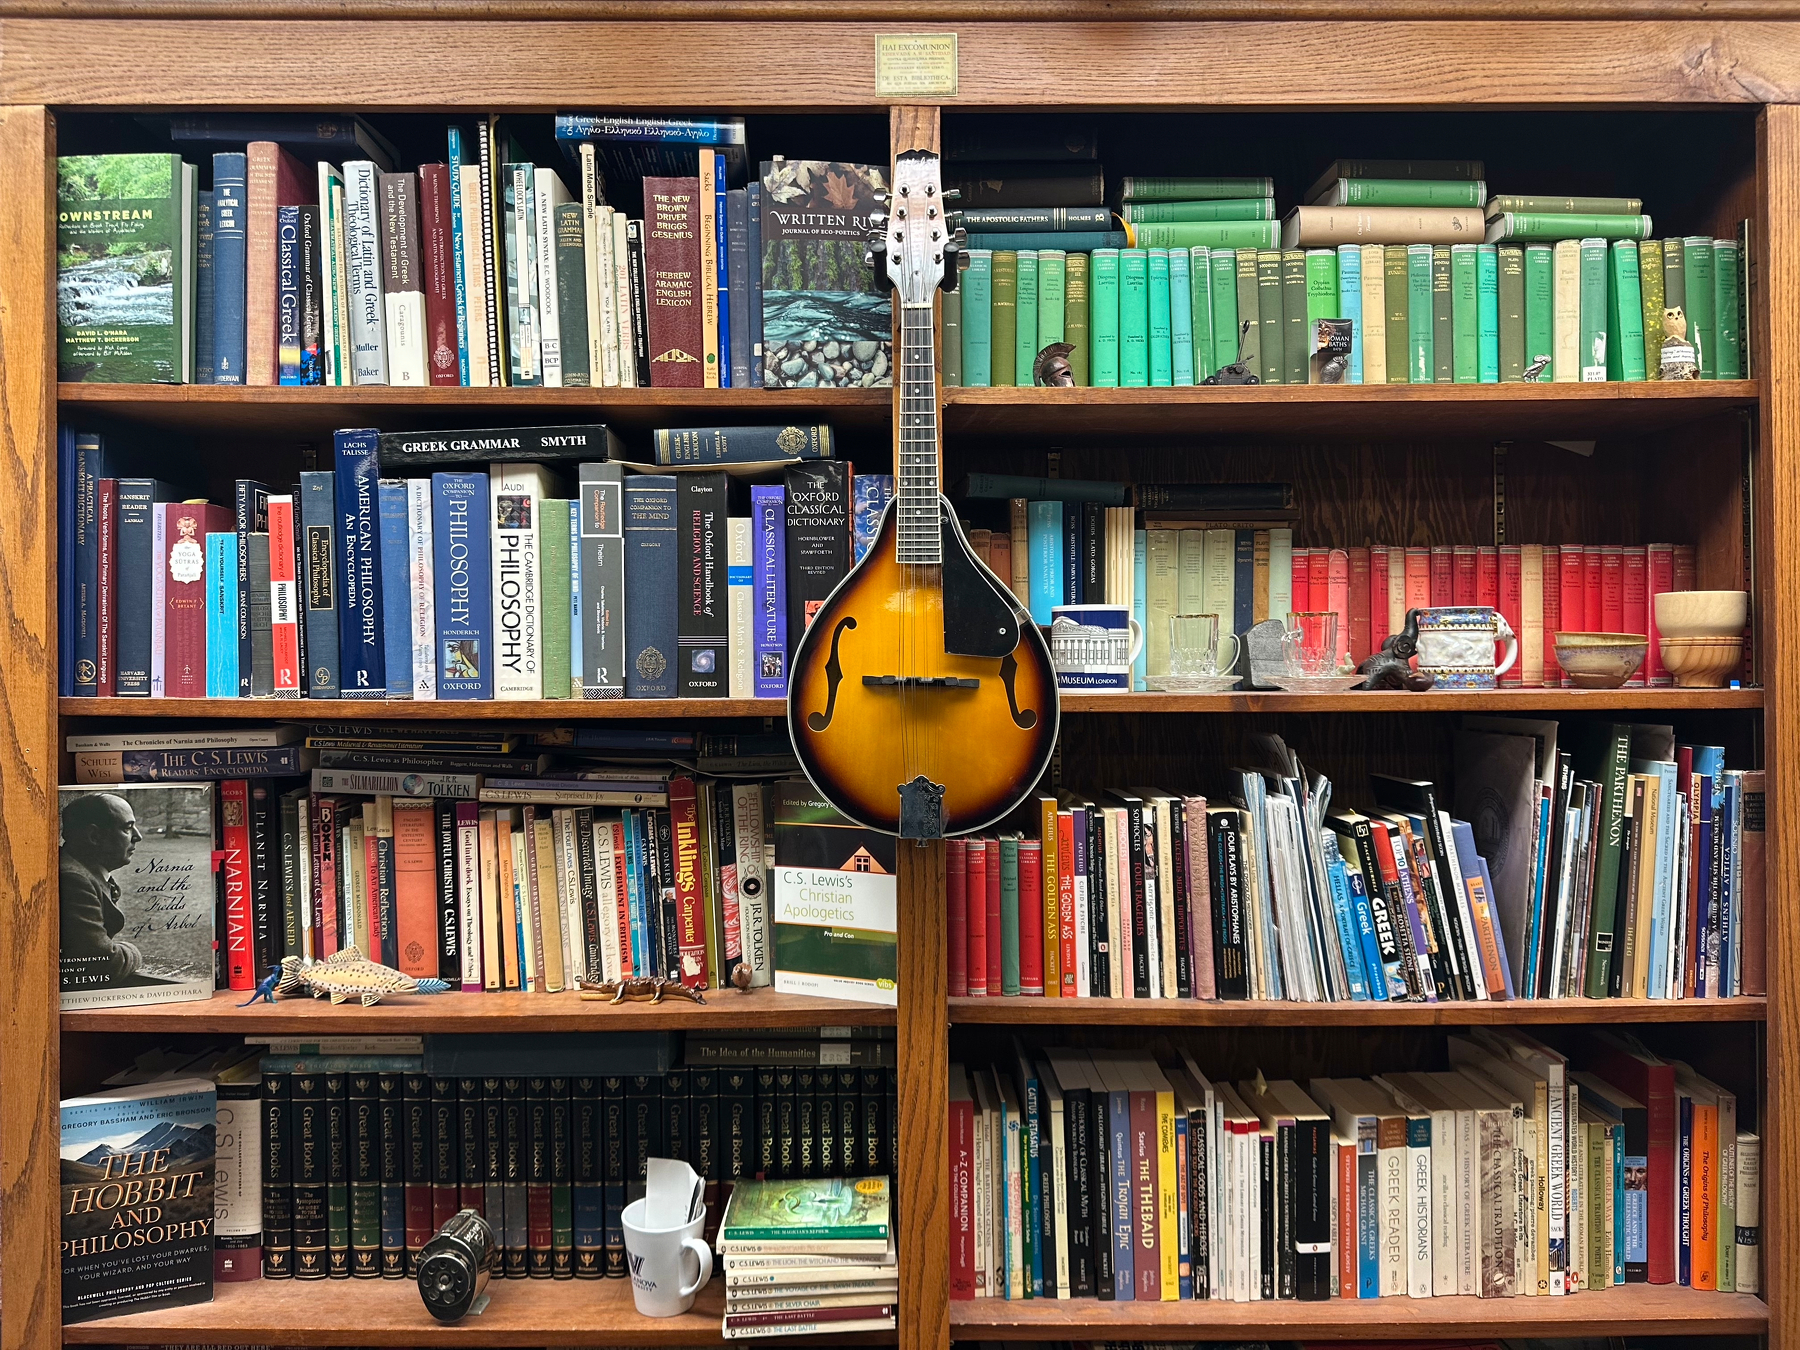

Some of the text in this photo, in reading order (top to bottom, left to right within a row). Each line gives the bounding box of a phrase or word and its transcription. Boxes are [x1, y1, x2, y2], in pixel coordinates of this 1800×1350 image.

[575, 115, 693, 126] Greek-English English-Greek
[586, 174, 594, 192] Made
[60, 210, 152, 222] OWNSTREAM
[388, 214, 396, 233] New
[656, 204, 687, 212] BROWN
[770, 211, 846, 226] WRITTEN
[397, 179, 409, 285] The Development of Greek
[651, 231, 693, 239] GESENIUS
[656, 222, 688, 230] BRIGGS
[782, 228, 810, 236] JOURNAL
[348, 201, 362, 294] Theological Terms
[358, 169, 379, 324] Dictionary of Latin and Greek
[390, 236, 398, 279] Testament
[281, 225, 298, 342] Classical Greek
[656, 289, 692, 298] ENGLISH
[656, 299, 692, 307] LEXICON
[358, 368, 378, 377] Baker
[402, 436, 587, 453] GREEK GRAMMAR SMYTH
[504, 484, 524, 492] AUDI
[793, 492, 840, 502] OXFORD
[787, 504, 845, 515] CLASSICAL
[787, 518, 845, 527] DICTIONARY
[358, 475, 374, 646] AMERICAN PHILOSOPHY
[450, 500, 469, 626] PHILOSOPHY
[692, 510, 702, 616] RELIGION AND SCIENCE
[704, 512, 714, 618] The Oxford Handbook of
[766, 509, 776, 642] CLASSICAL LITERATURE
[278, 583, 286, 621] PHILOSOPHY
[500, 536, 521, 673] PHILOSOPHY
[524, 534, 535, 674] THE CAMBRIDGE DICTIONARY OF
[443, 682, 481, 690] OXFORD
[1061, 676, 1094, 684] MUSEUM
[80, 757, 117, 766] SCHULTZ
[160, 751, 268, 767] THE C. S. LEWIS
[161, 765, 268, 777] READERS' ENCYCLOPEDIA
[350, 774, 399, 791] SILMARILLION
[427, 781, 470, 797] TOLKIEN
[1608, 734, 1628, 848] THE PARTHENON
[135, 858, 194, 874] Narnia
[256, 812, 268, 940] PLANET NARNIA
[1047, 853, 1055, 872] THE
[1133, 808, 1144, 936] SOPHOCLES FOUR TRAGEDIES
[137, 876, 192, 893] and the
[378, 840, 390, 940] Christian Reflections
[677, 821, 698, 943] Inklings Carpenter
[784, 871, 853, 888] C.S. Lewis's
[800, 888, 852, 904] Christian
[1228, 832, 1240, 944] FOUR PLAYS BY ARISTOPHANES
[1400, 871, 1414, 904] ATHENS
[144, 893, 186, 912] Fields
[226, 849, 245, 951] NARNIAN
[784, 904, 854, 921] Apologetics
[1046, 876, 1056, 918] GOLDEN
[132, 914, 202, 938] of Arbol
[1049, 922, 1057, 940] ASS
[1372, 898, 1396, 955] GREEK
[1028, 1087, 1038, 1158] CATTUS PETASATUS
[270, 1106, 282, 1178] Great Books
[1550, 1096, 1564, 1220] ANCIENT GREEK WORLD
[100, 1148, 171, 1181] THE
[65, 1172, 203, 1216] HOBBIT
[960, 1170, 968, 1231] COMPANION
[1140, 1160, 1154, 1248] THE THEBAID
[1388, 1156, 1400, 1264] GREEK READER
[1416, 1155, 1428, 1260] GREEK HISTORIANS
[1537, 1176, 1546, 1212] Holloway
[1701, 1151, 1710, 1241] The Origins of Philosophy
[109, 1206, 163, 1230] AND
[61, 1218, 213, 1258] PHILOSOPHY
